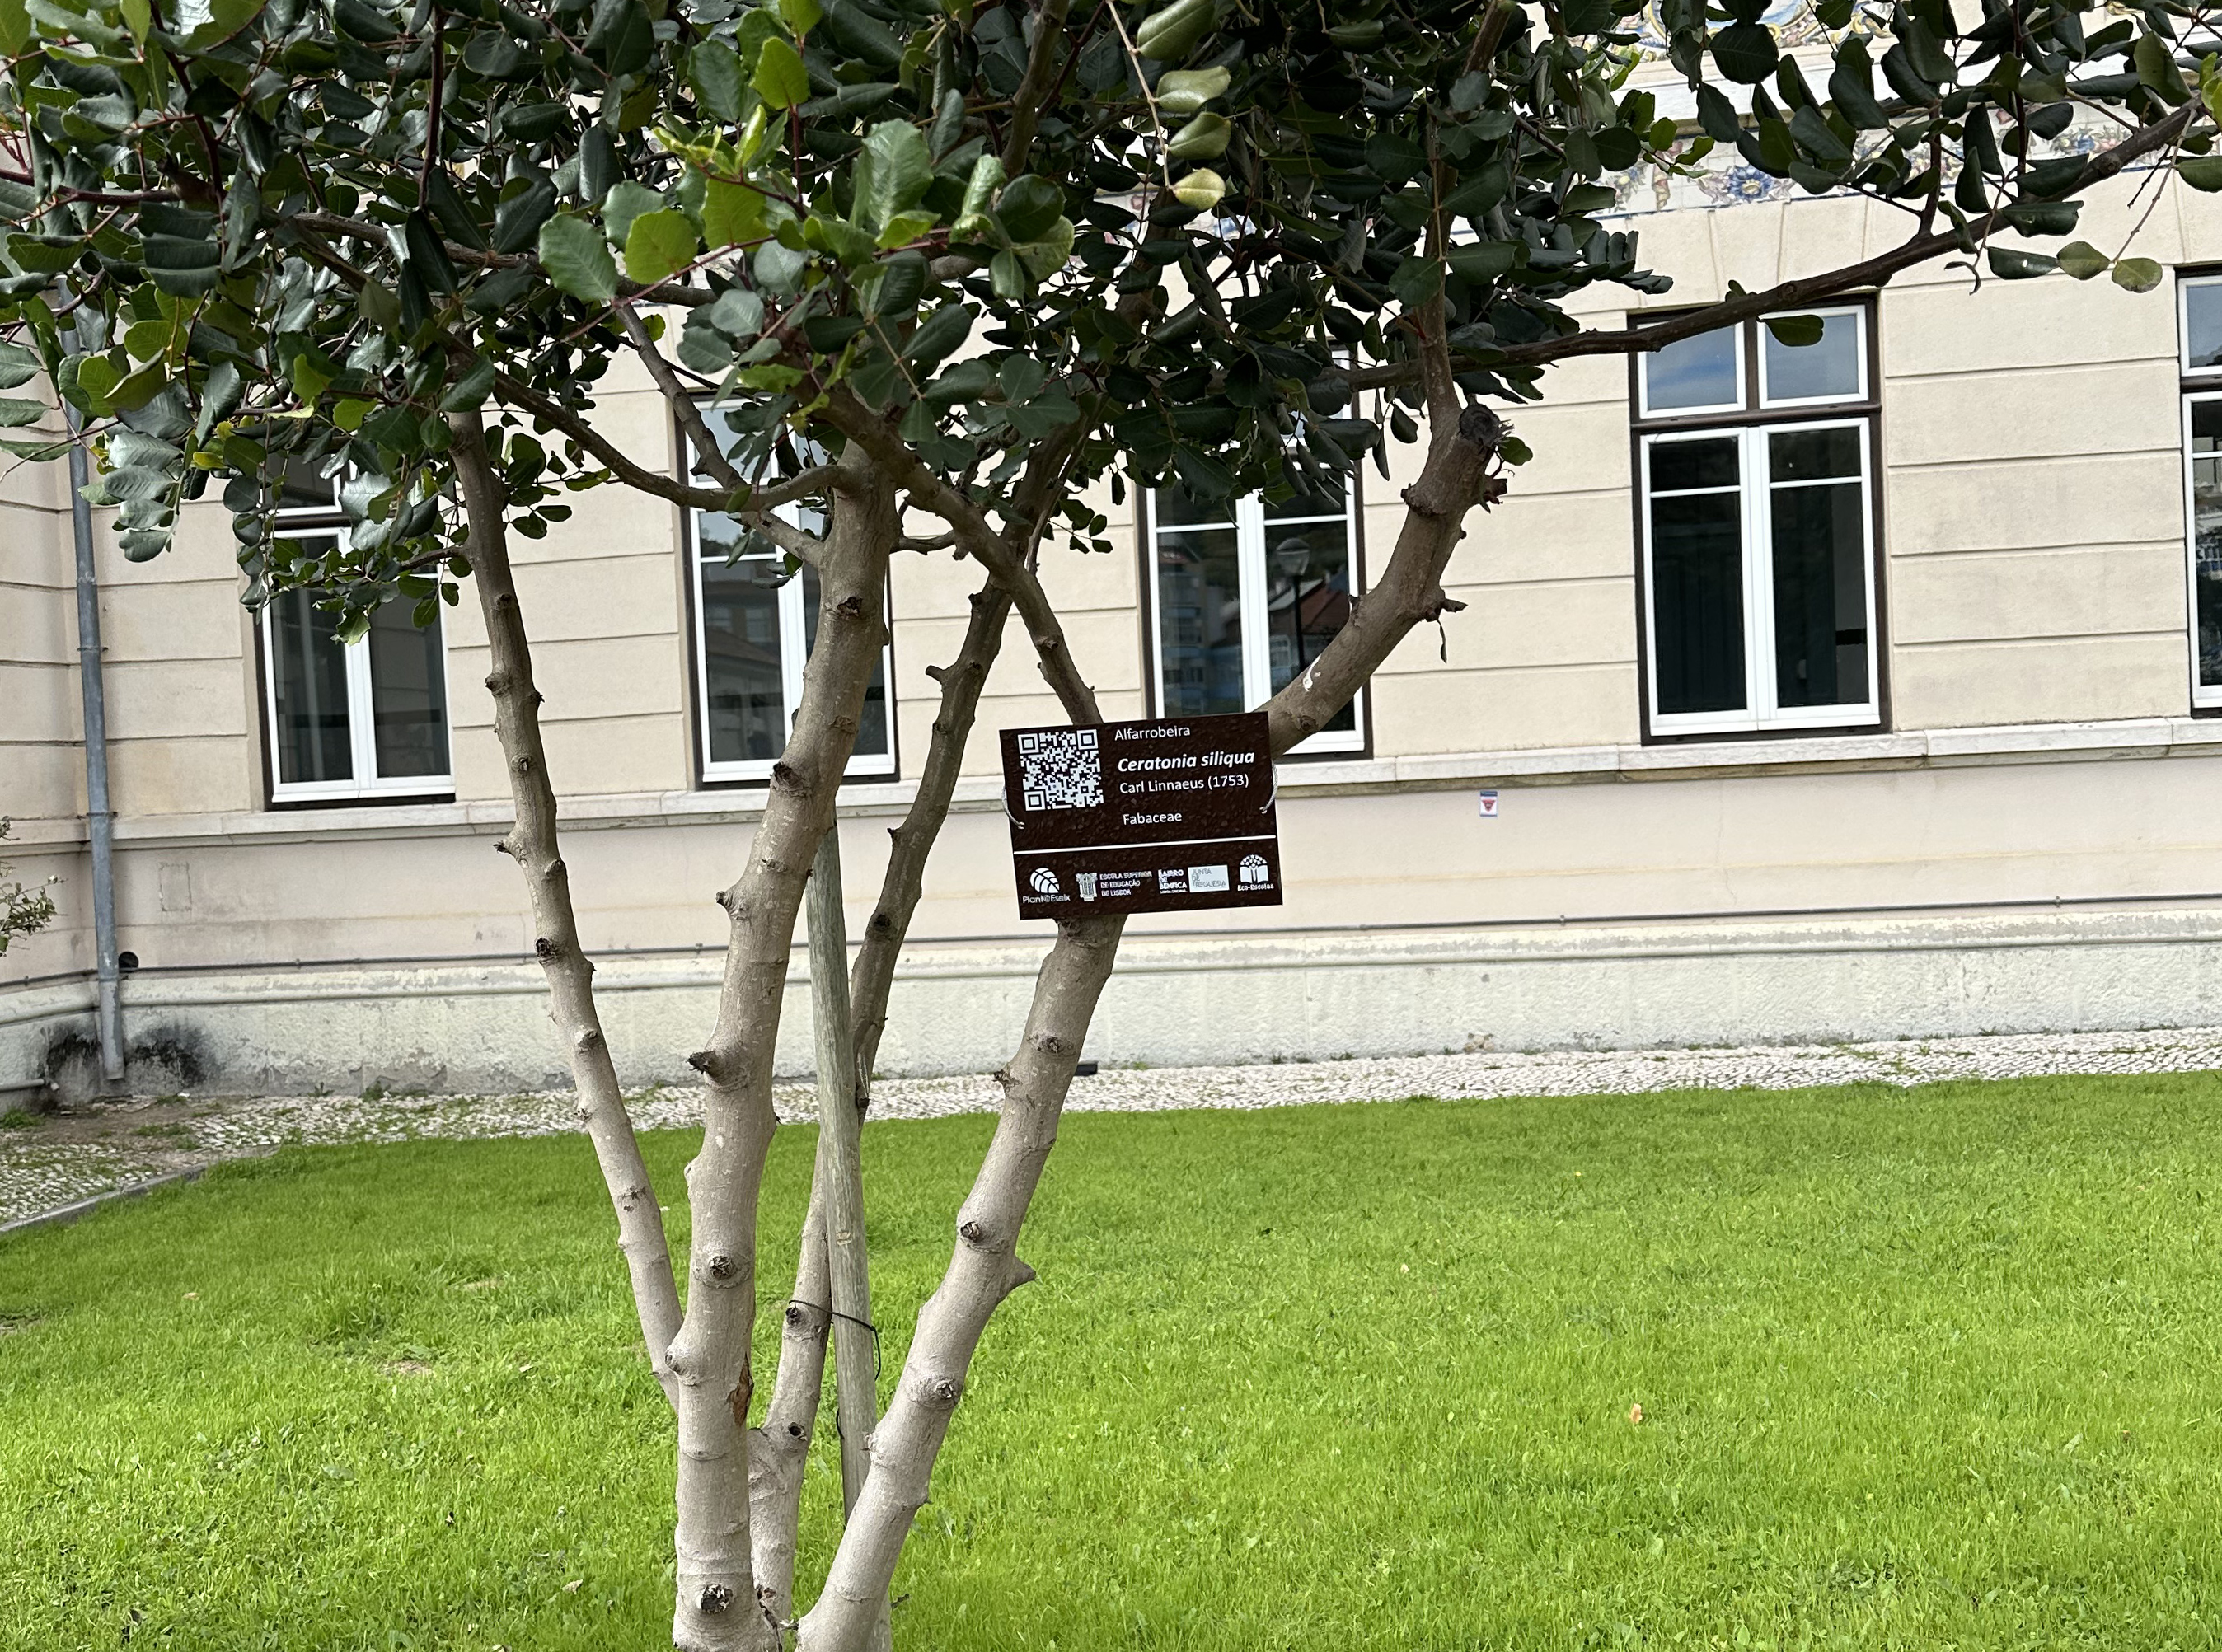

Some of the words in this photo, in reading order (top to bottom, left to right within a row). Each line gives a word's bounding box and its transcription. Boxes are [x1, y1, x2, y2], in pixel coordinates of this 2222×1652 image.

[1114, 726, 1191, 741] Alfarrobeira
[1118, 753, 1196, 772] Ceratonia
[1201, 751, 1255, 770] siliqua
[1119, 781, 1145, 794] Carl
[1148, 779, 1204, 793] Linnaeus
[1207, 774, 1249, 790] (1753)
[1123, 812, 1183, 825] Fabaceae
[1099, 872, 1123, 880] ESCOLA
